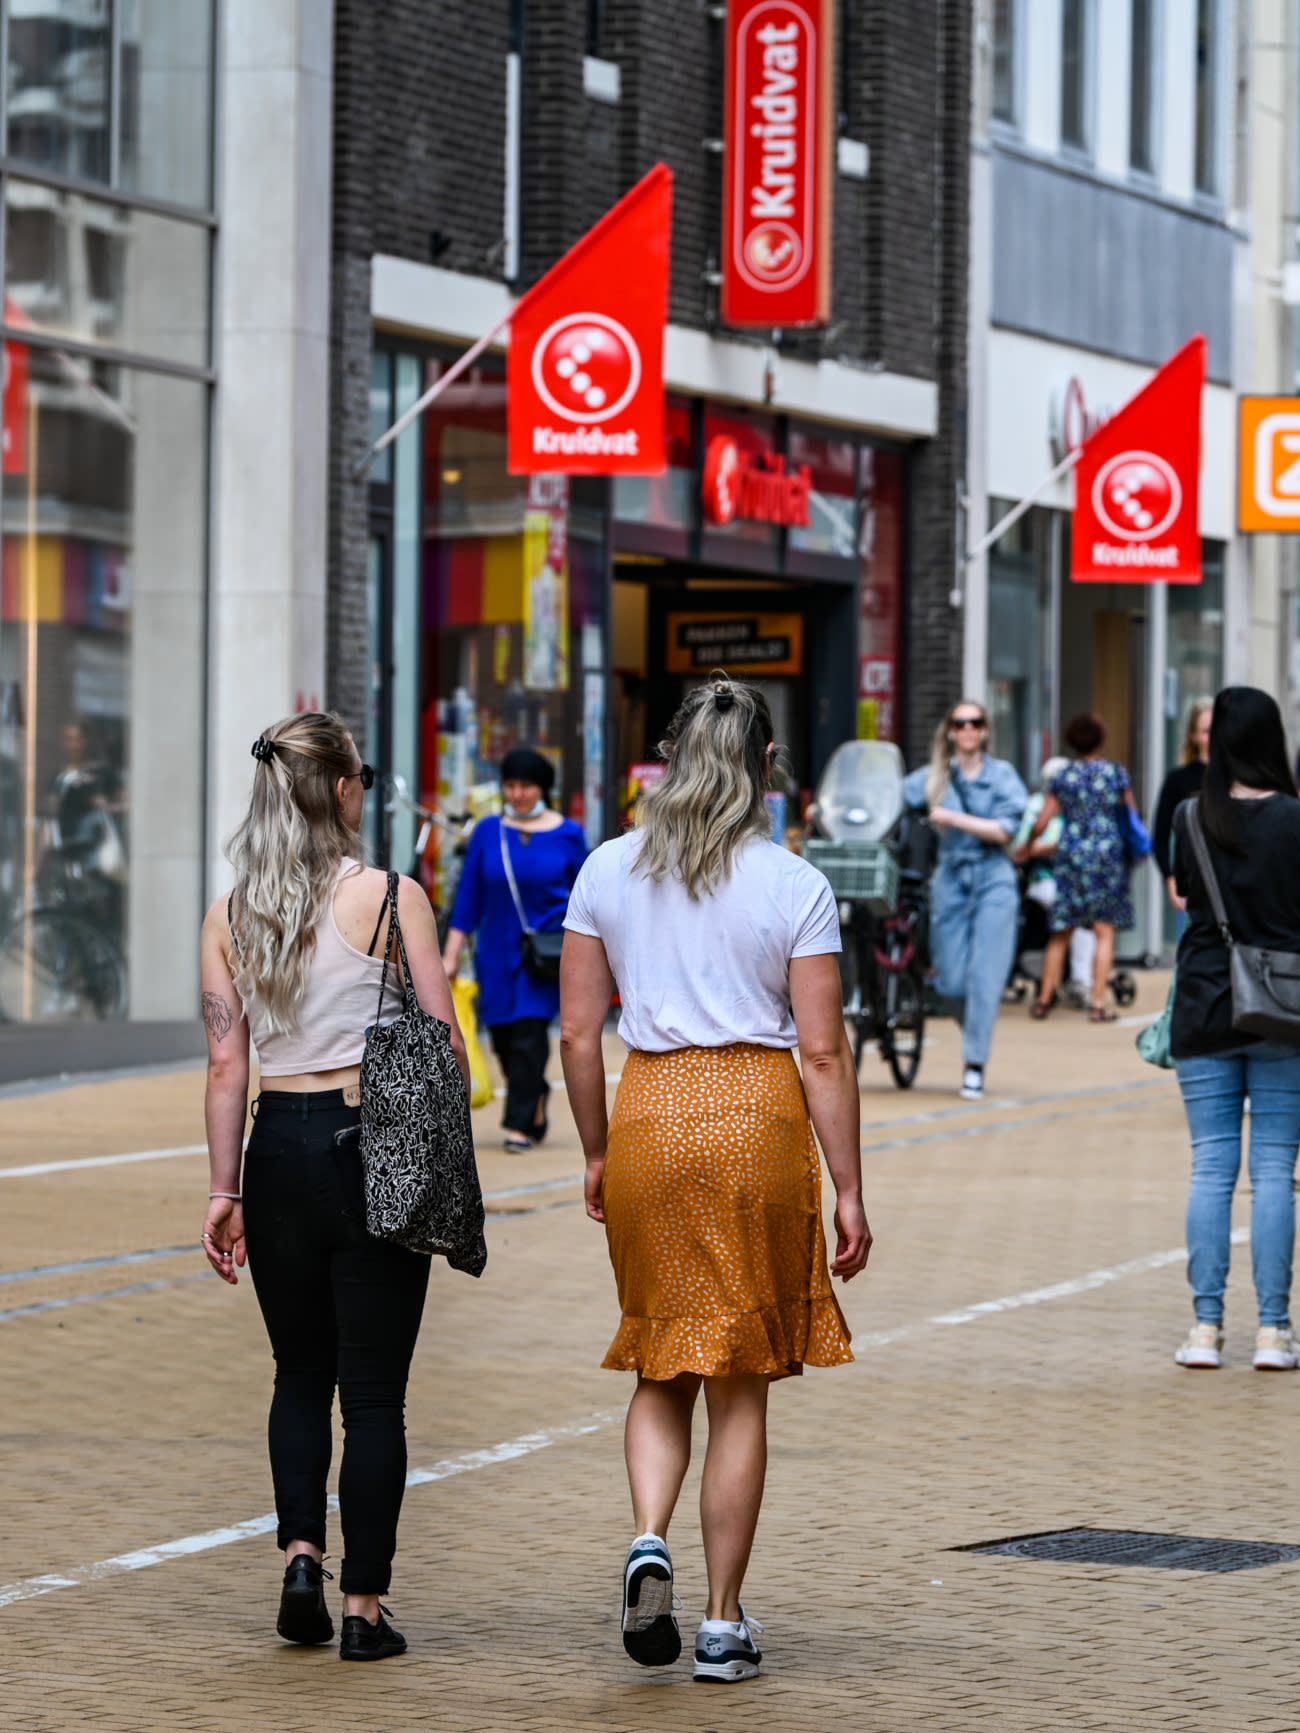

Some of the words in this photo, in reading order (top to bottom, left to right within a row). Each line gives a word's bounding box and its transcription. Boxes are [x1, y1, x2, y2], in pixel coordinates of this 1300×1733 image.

[750, 22, 799, 218] Kruidvat
[532, 425, 640, 457] Kruidvat
[1091, 541, 1180, 569] Kruidvat
